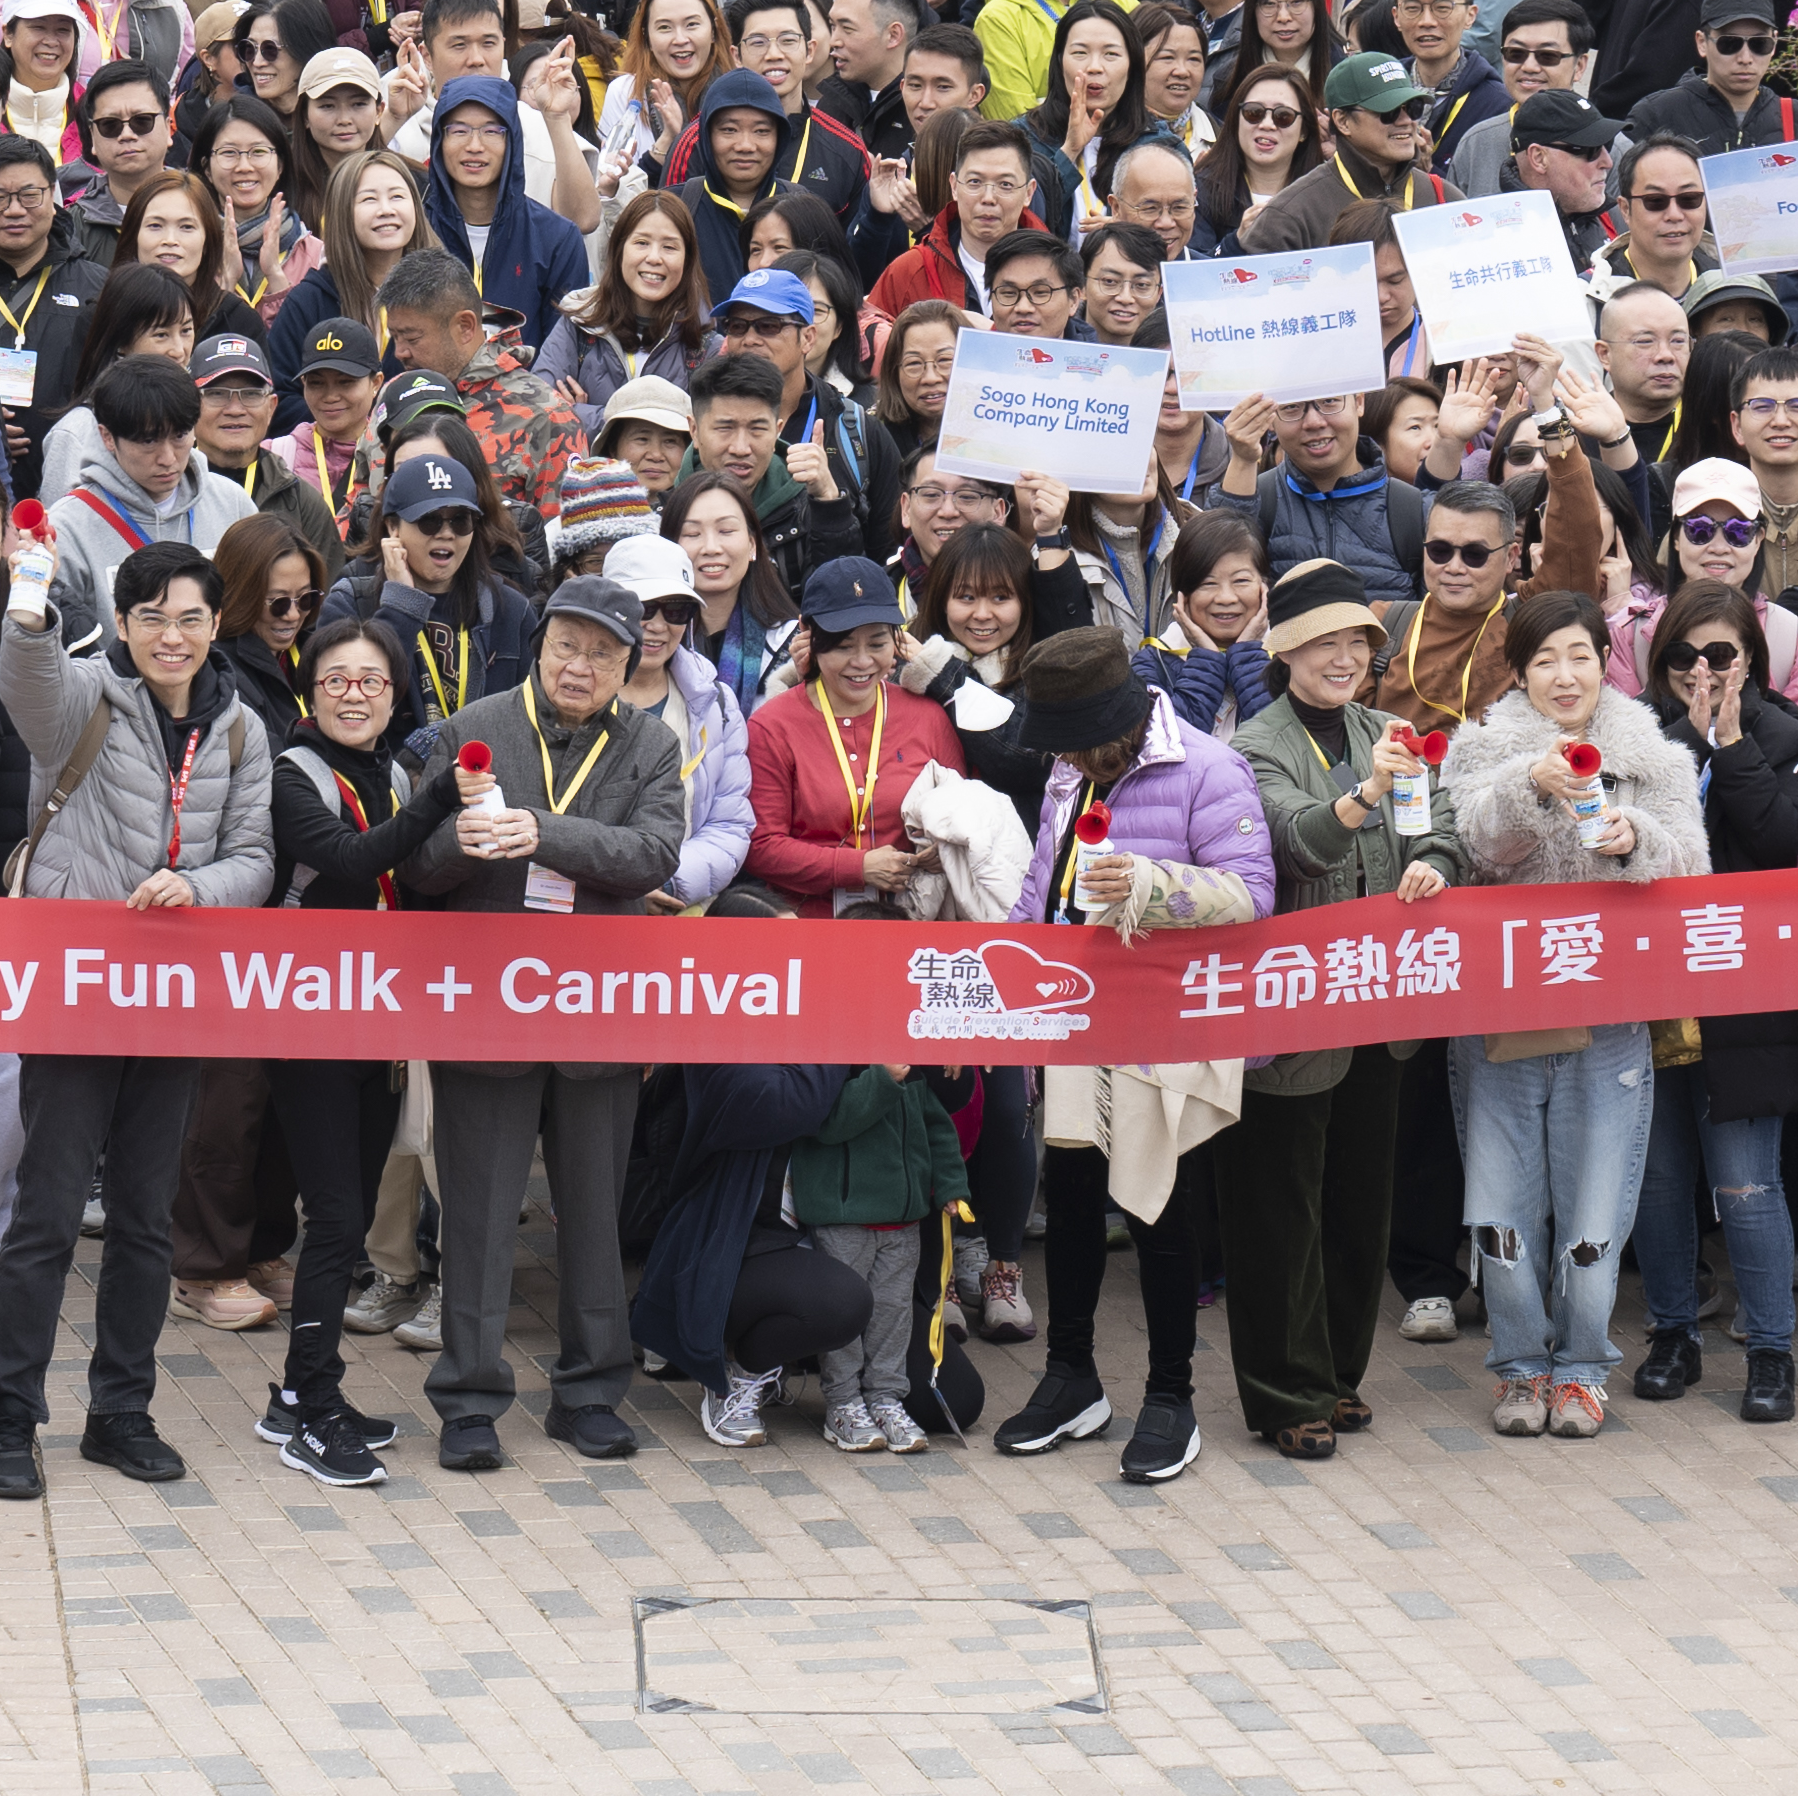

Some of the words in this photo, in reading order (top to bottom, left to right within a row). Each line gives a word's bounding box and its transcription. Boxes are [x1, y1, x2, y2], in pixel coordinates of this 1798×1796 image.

[1448, 256, 1554, 291] 生命共行義工隊
[1191, 325, 1255, 344] Hotline
[1261, 310, 1359, 341] 熱線義工隊
[316, 332, 344, 351] alo
[979, 385, 1027, 412] Sogo
[1031, 391, 1080, 418] Hong
[1084, 396, 1129, 423] Kong
[973, 404, 1059, 432] Company
[1064, 413, 1129, 436] Limited
[425, 462, 452, 490] LA
[913, 953, 982, 981] 生命
[64, 948, 196, 1009] Fun
[220, 950, 402, 1013] Walk
[427, 966, 472, 1014] +
[500, 956, 802, 1018] Carnival
[927, 981, 994, 1009] 熱線
[914, 1015, 960, 1025] Suicide
[964, 1015, 1030, 1026] Prevention
[1032, 1016, 1086, 1027] Services
[303, 1431, 326, 1457] HOKA
